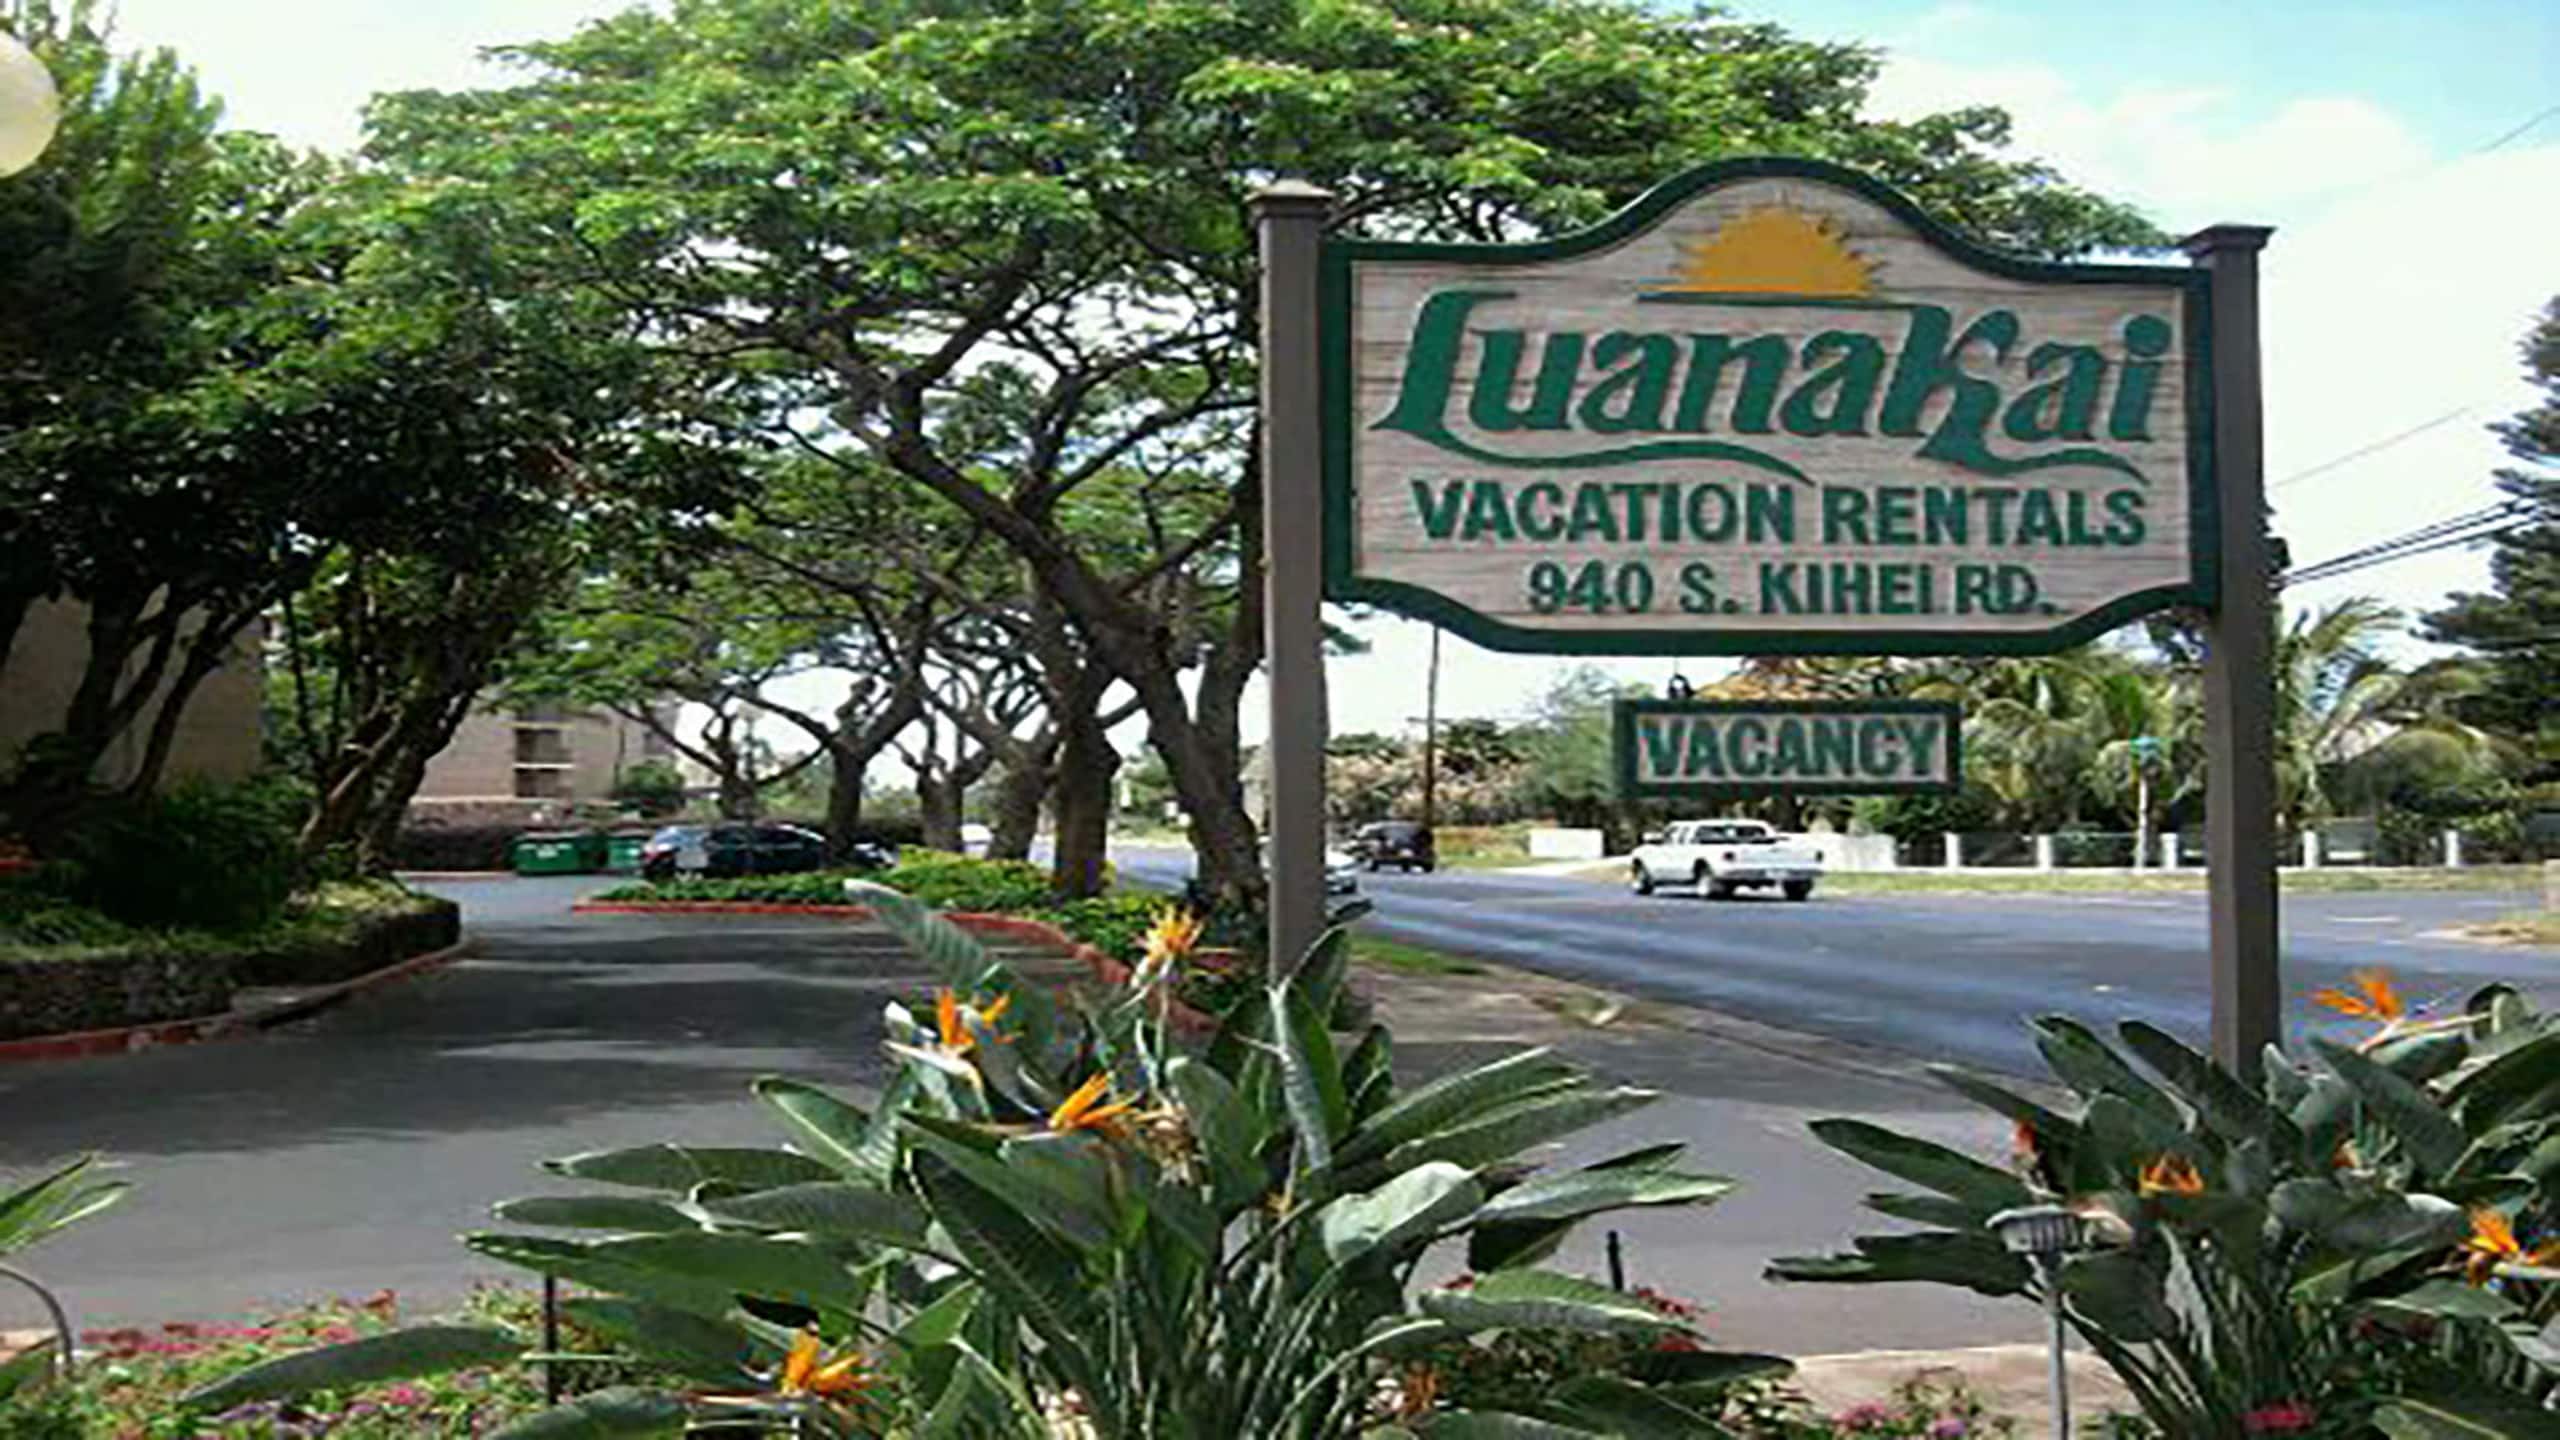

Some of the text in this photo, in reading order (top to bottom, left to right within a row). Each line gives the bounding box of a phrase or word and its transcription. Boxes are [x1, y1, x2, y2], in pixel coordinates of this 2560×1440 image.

[1411, 481, 2146, 547] VACATION RENTALS
[1529, 560, 2060, 616] 940 S. KIHEI RD.
[1641, 717, 1943, 777] VACANCY
